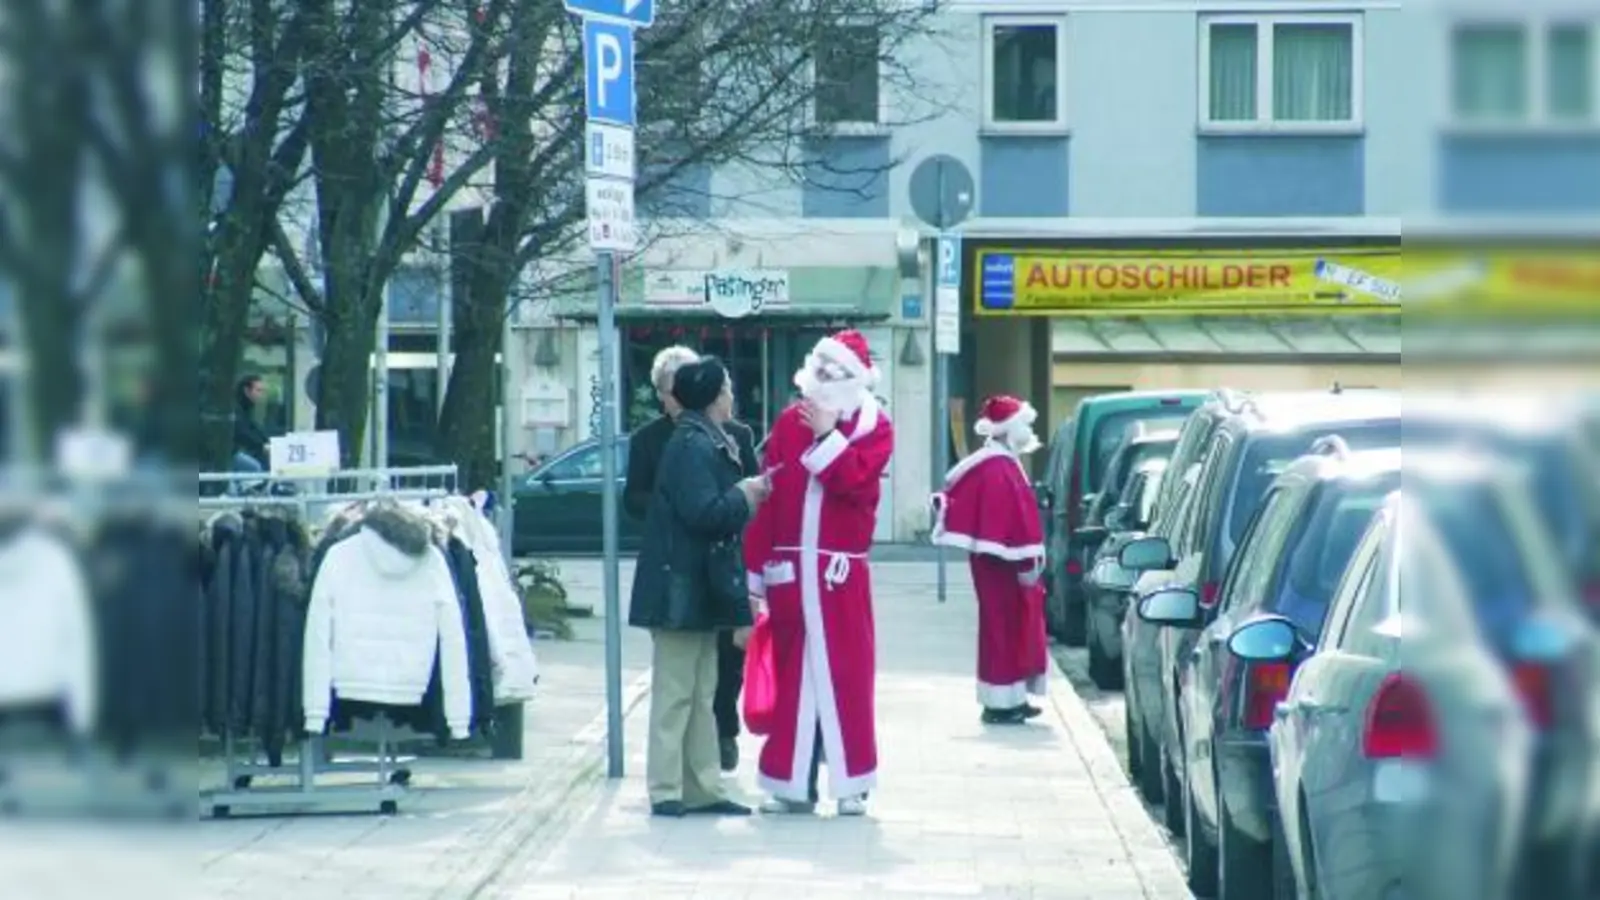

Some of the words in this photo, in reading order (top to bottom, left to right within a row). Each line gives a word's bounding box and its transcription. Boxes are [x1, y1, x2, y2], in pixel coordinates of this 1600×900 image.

[595, 33, 623, 108] P
[940, 239, 955, 282] P
[1026, 263, 1291, 289] AUTOSCHILDER
